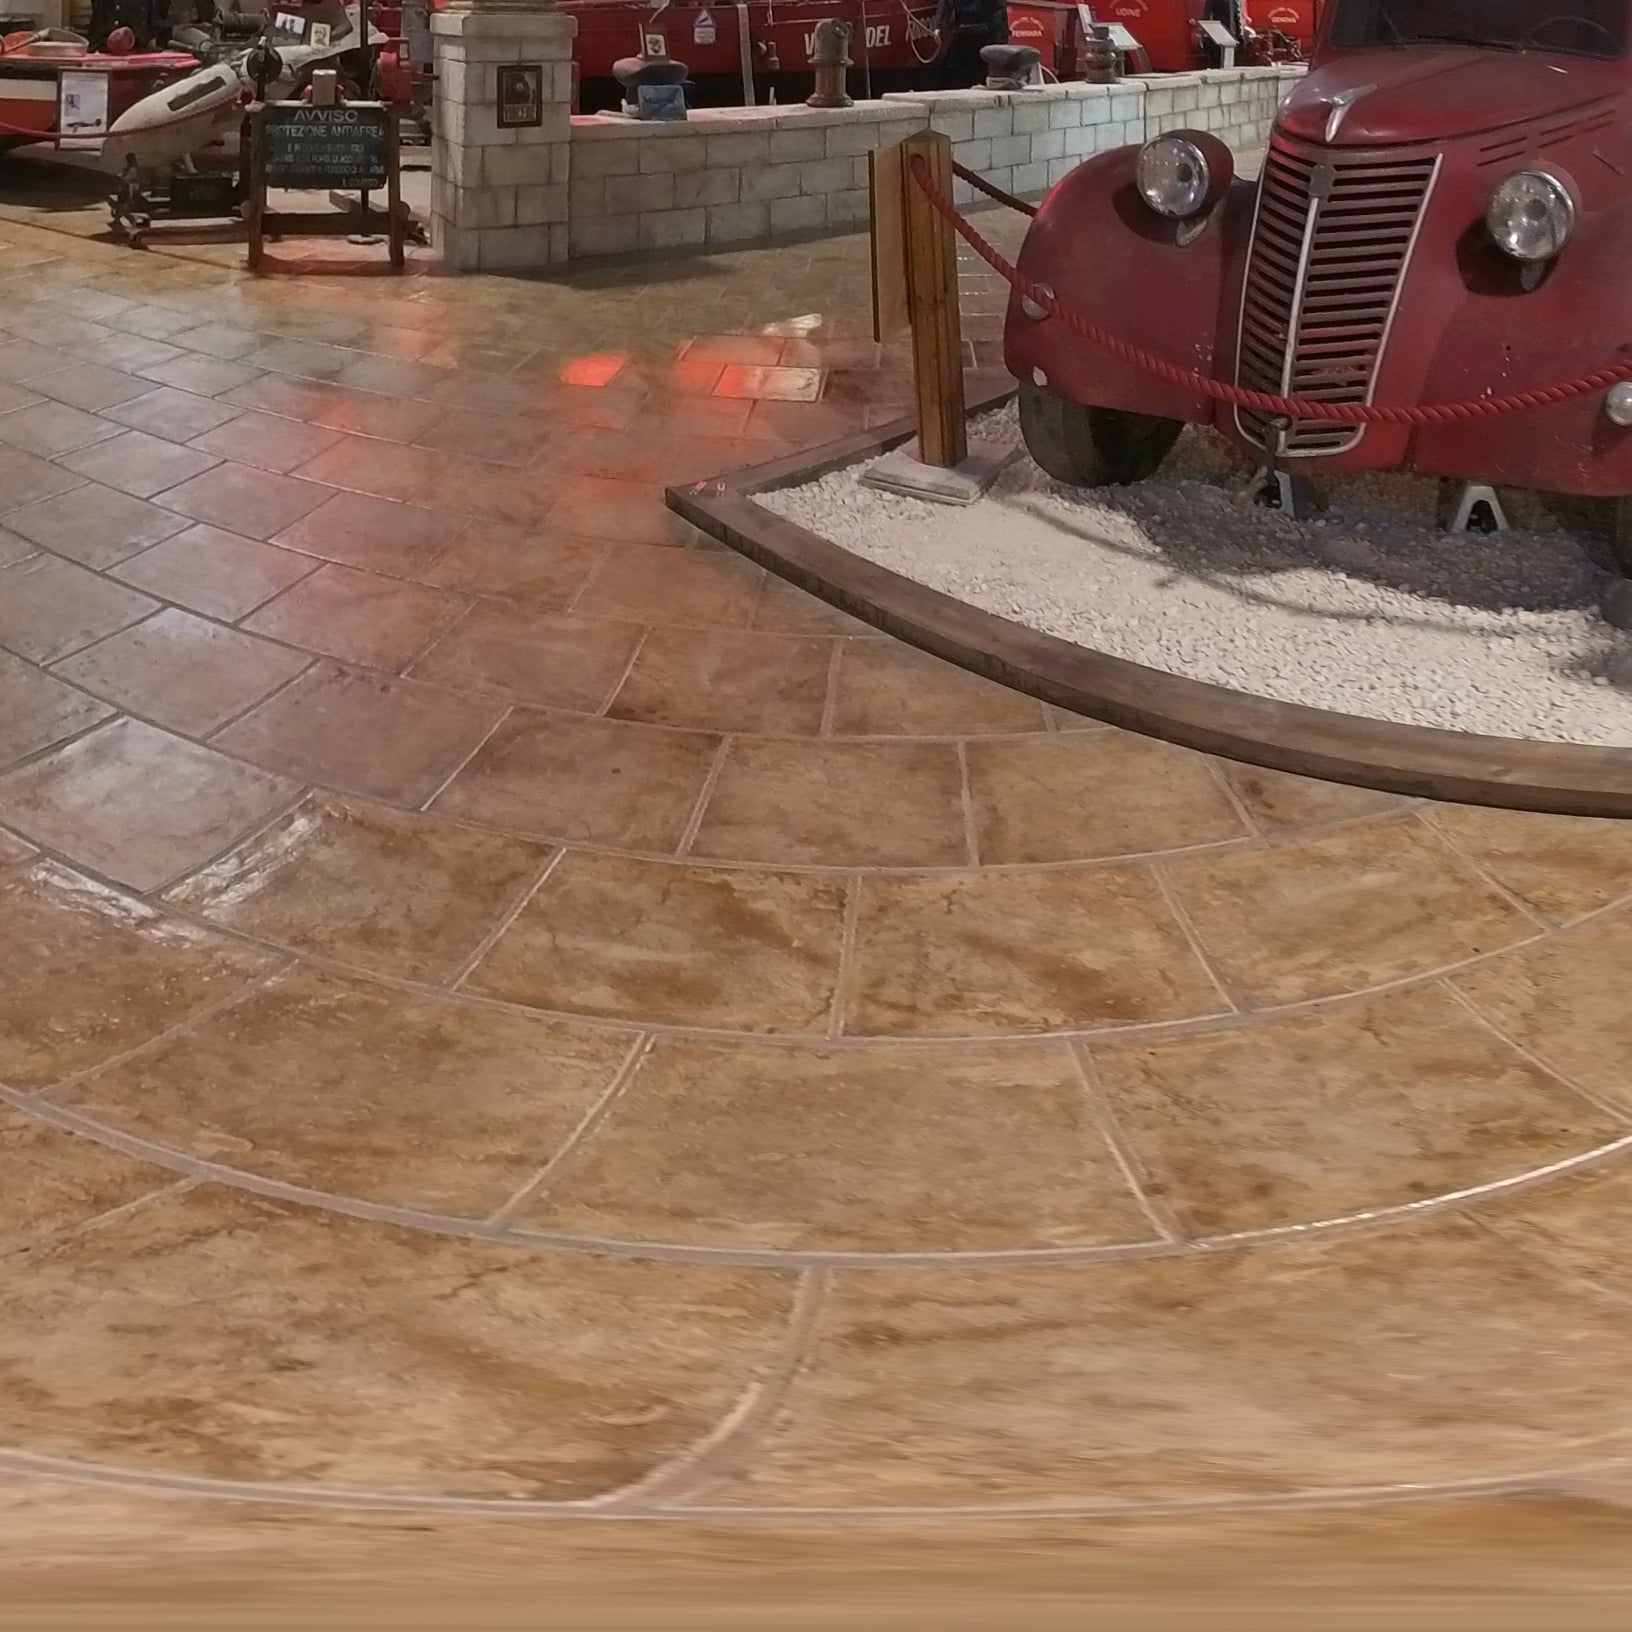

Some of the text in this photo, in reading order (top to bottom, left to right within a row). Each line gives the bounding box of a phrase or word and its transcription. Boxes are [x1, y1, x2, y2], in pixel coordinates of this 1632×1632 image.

[866, 25, 891, 48] DEL
[294, 110, 358, 122] AVVISO
[265, 125, 327, 137] PROTEZIONE
